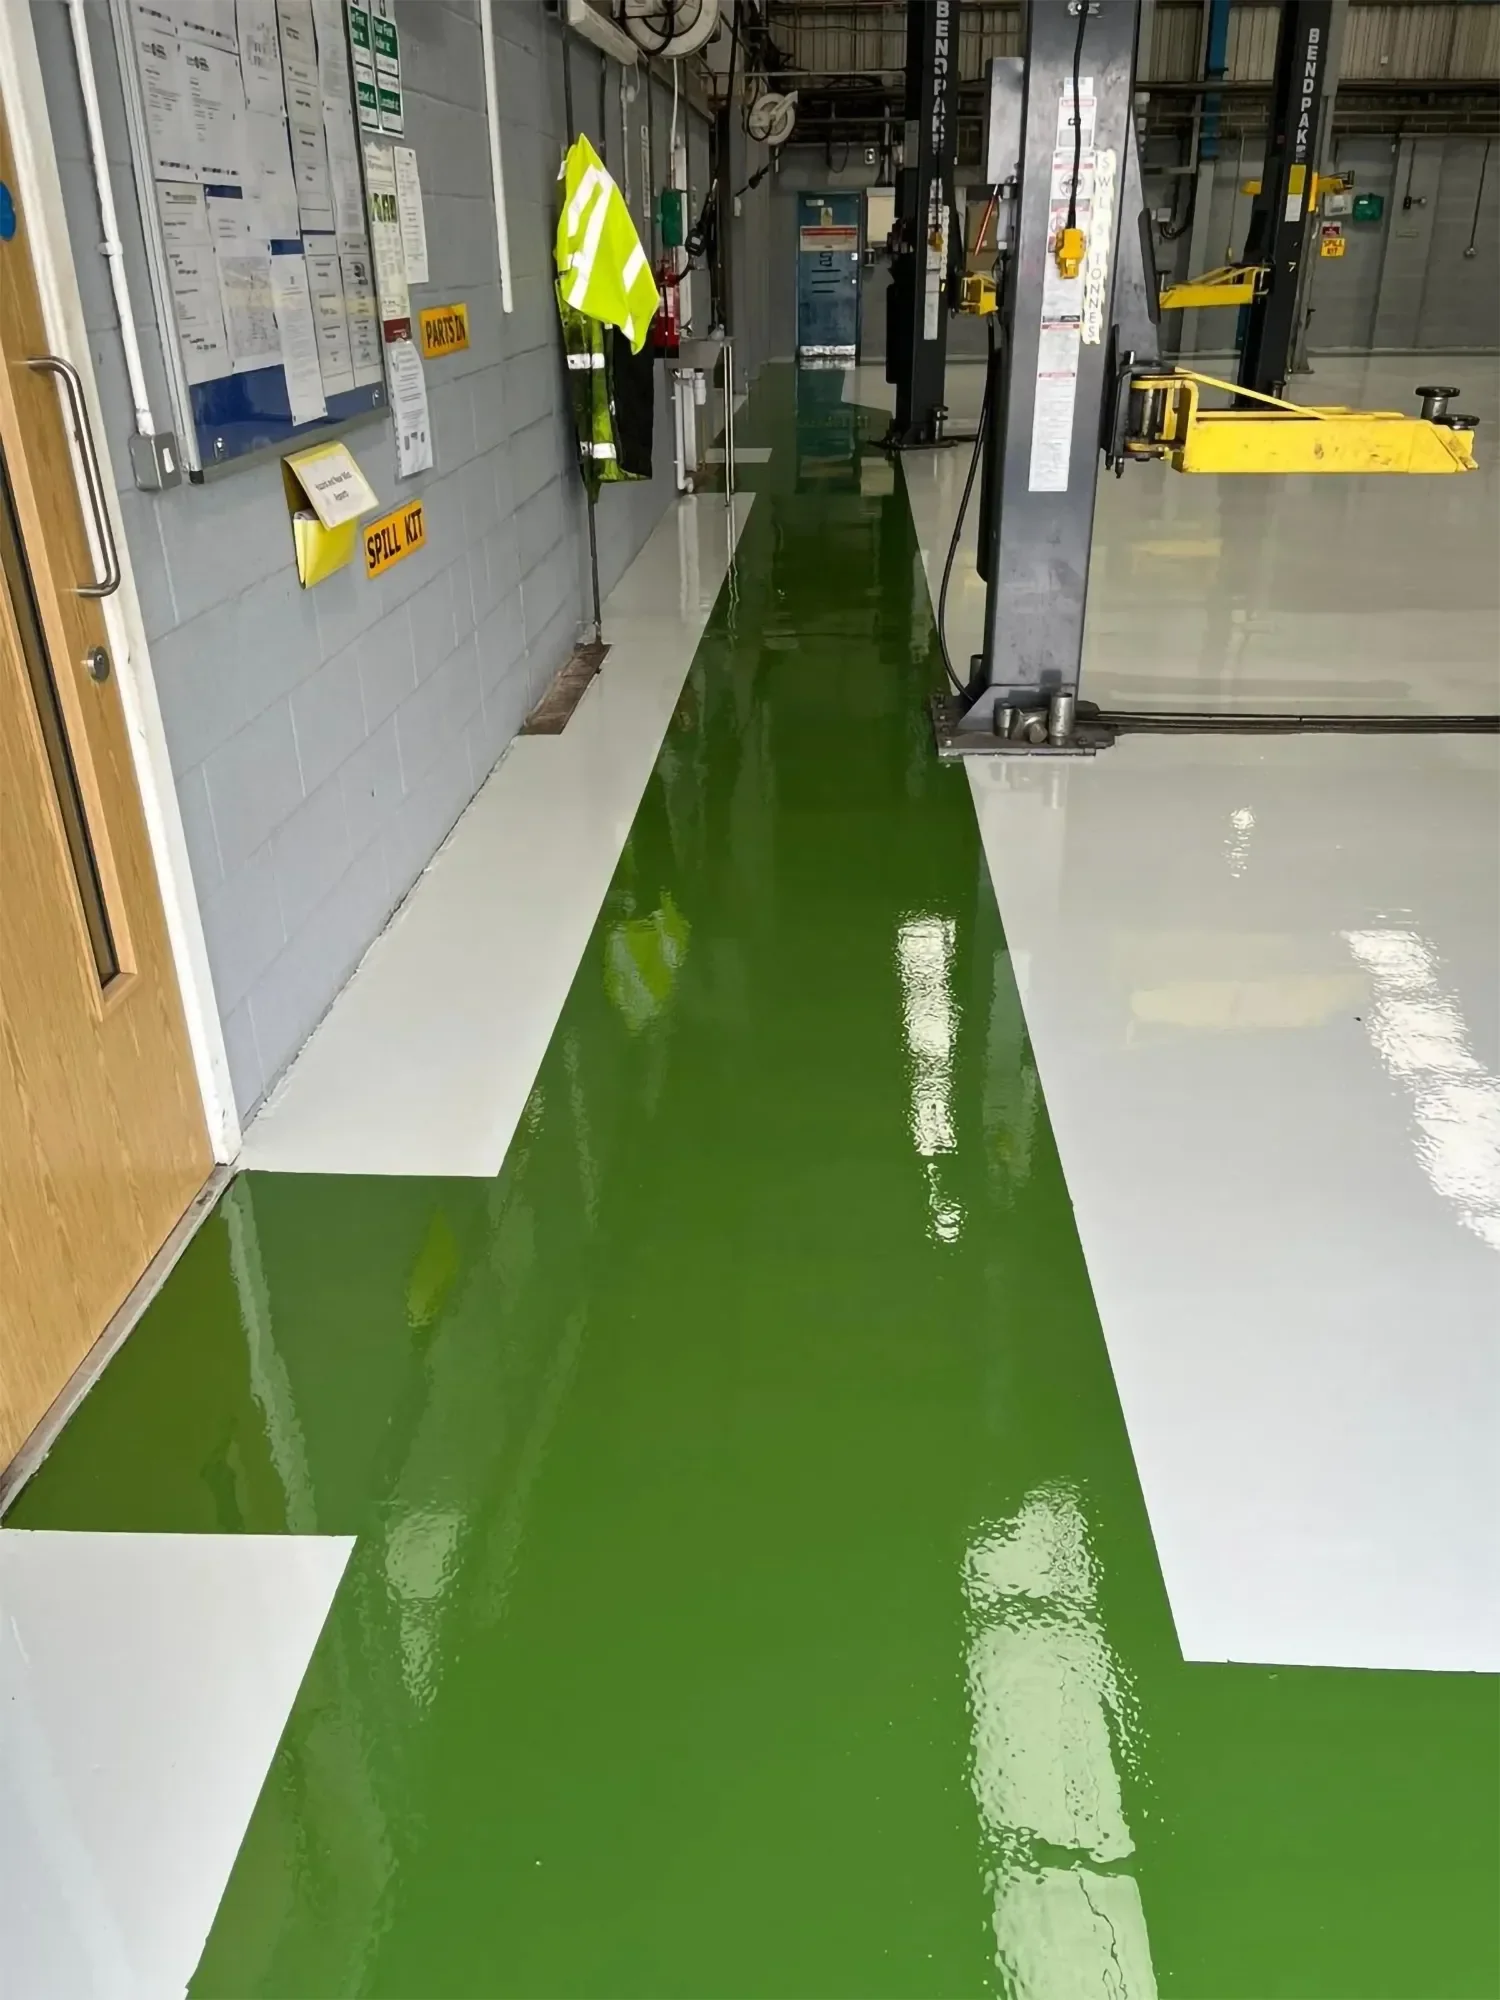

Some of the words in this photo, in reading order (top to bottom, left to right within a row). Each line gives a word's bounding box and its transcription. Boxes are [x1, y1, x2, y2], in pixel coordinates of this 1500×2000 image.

[1297, 28, 1320, 144] BENDPAK
[425, 316, 455, 348] PARTS
[455, 314, 466, 341] IN
[1088, 253, 1102, 338] TONNES
[367, 523, 401, 569] SPILL
[404, 508, 422, 546] KIT
